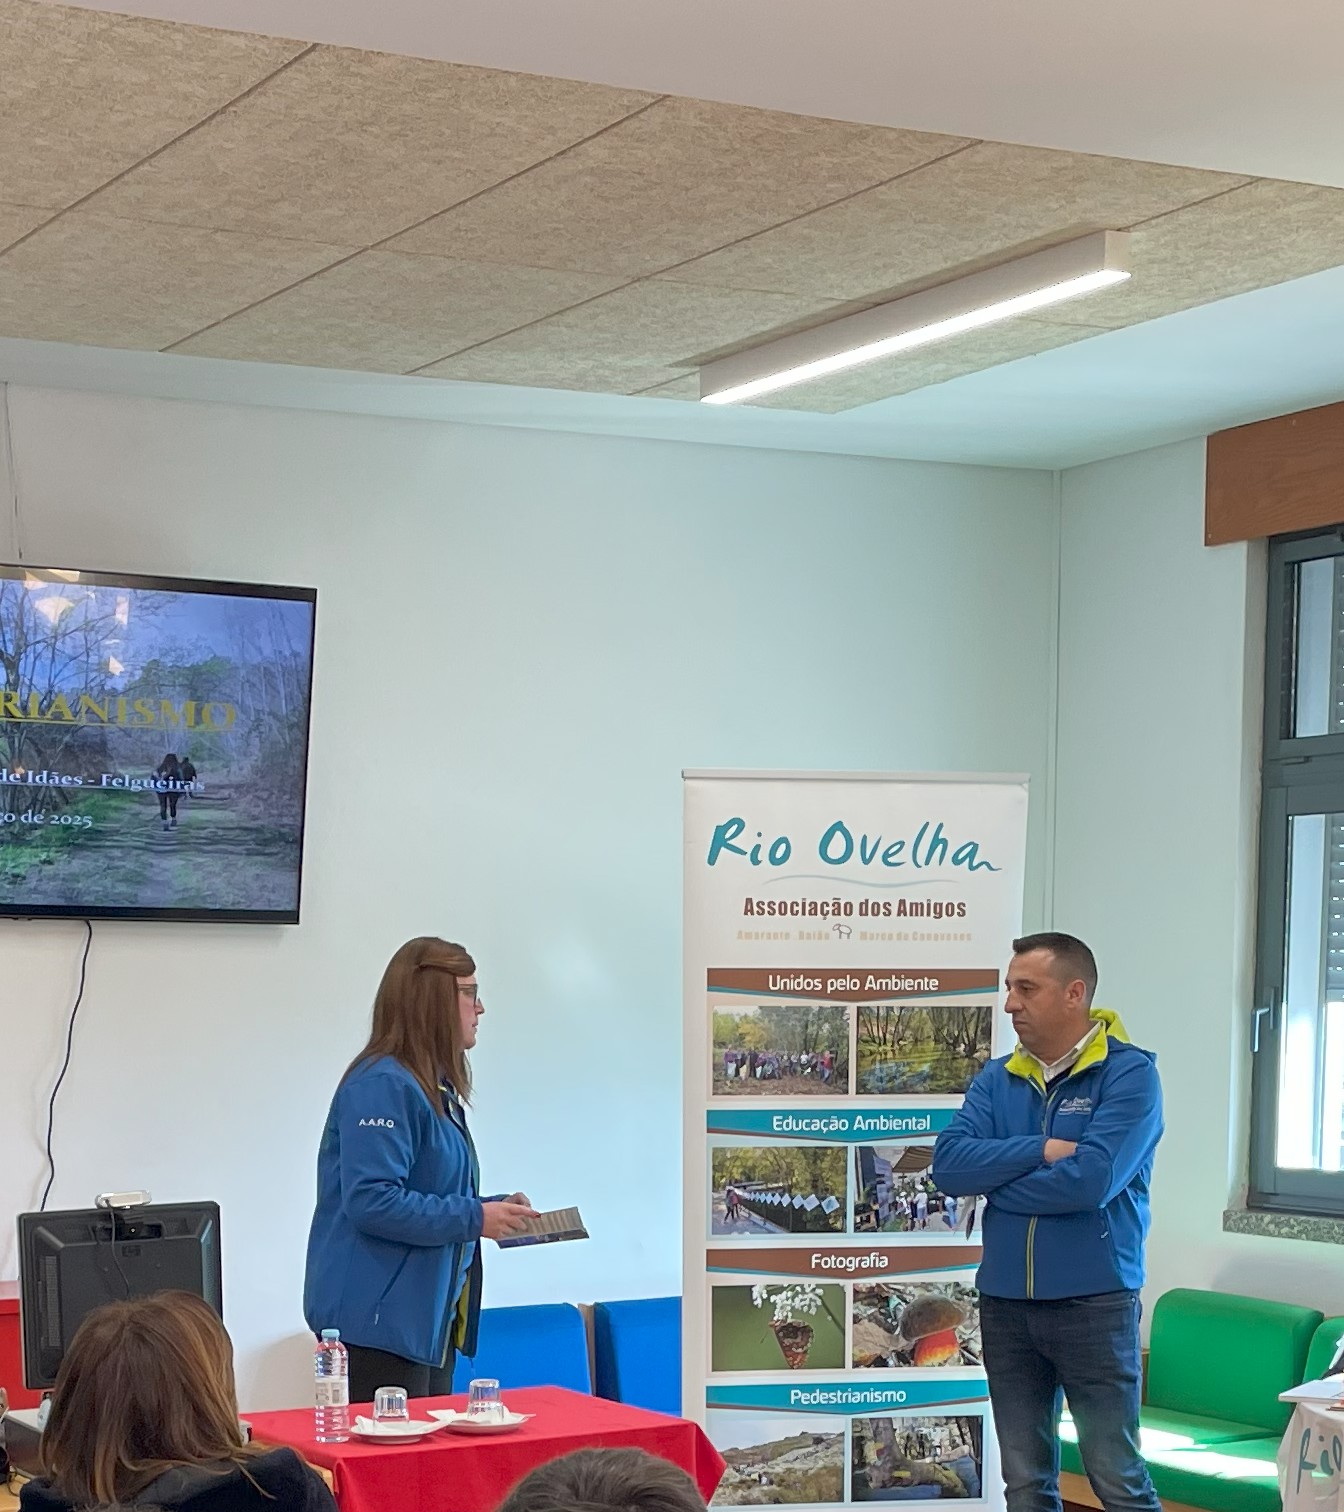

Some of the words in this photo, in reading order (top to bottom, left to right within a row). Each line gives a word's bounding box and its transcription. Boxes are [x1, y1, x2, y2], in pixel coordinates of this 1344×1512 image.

[26, 769, 84, 786] Idães
[100, 773, 206, 792] Felgueiras
[20, 809, 45, 824] de
[49, 814, 93, 829] 2025
[707, 816, 792, 867] Rio
[817, 819, 1003, 872] Ovelha
[743, 897, 854, 920] Associação
[858, 898, 892, 918] dos
[896, 898, 967, 920] Amigos
[768, 973, 823, 991] Unidos
[826, 974, 861, 995] pelo
[864, 974, 940, 992] Ambiente
[772, 1114, 849, 1135] Educação
[853, 1114, 931, 1132] Ambiental
[811, 1252, 890, 1273] Fotografia
[789, 1388, 907, 1406] Pedestrianismo
